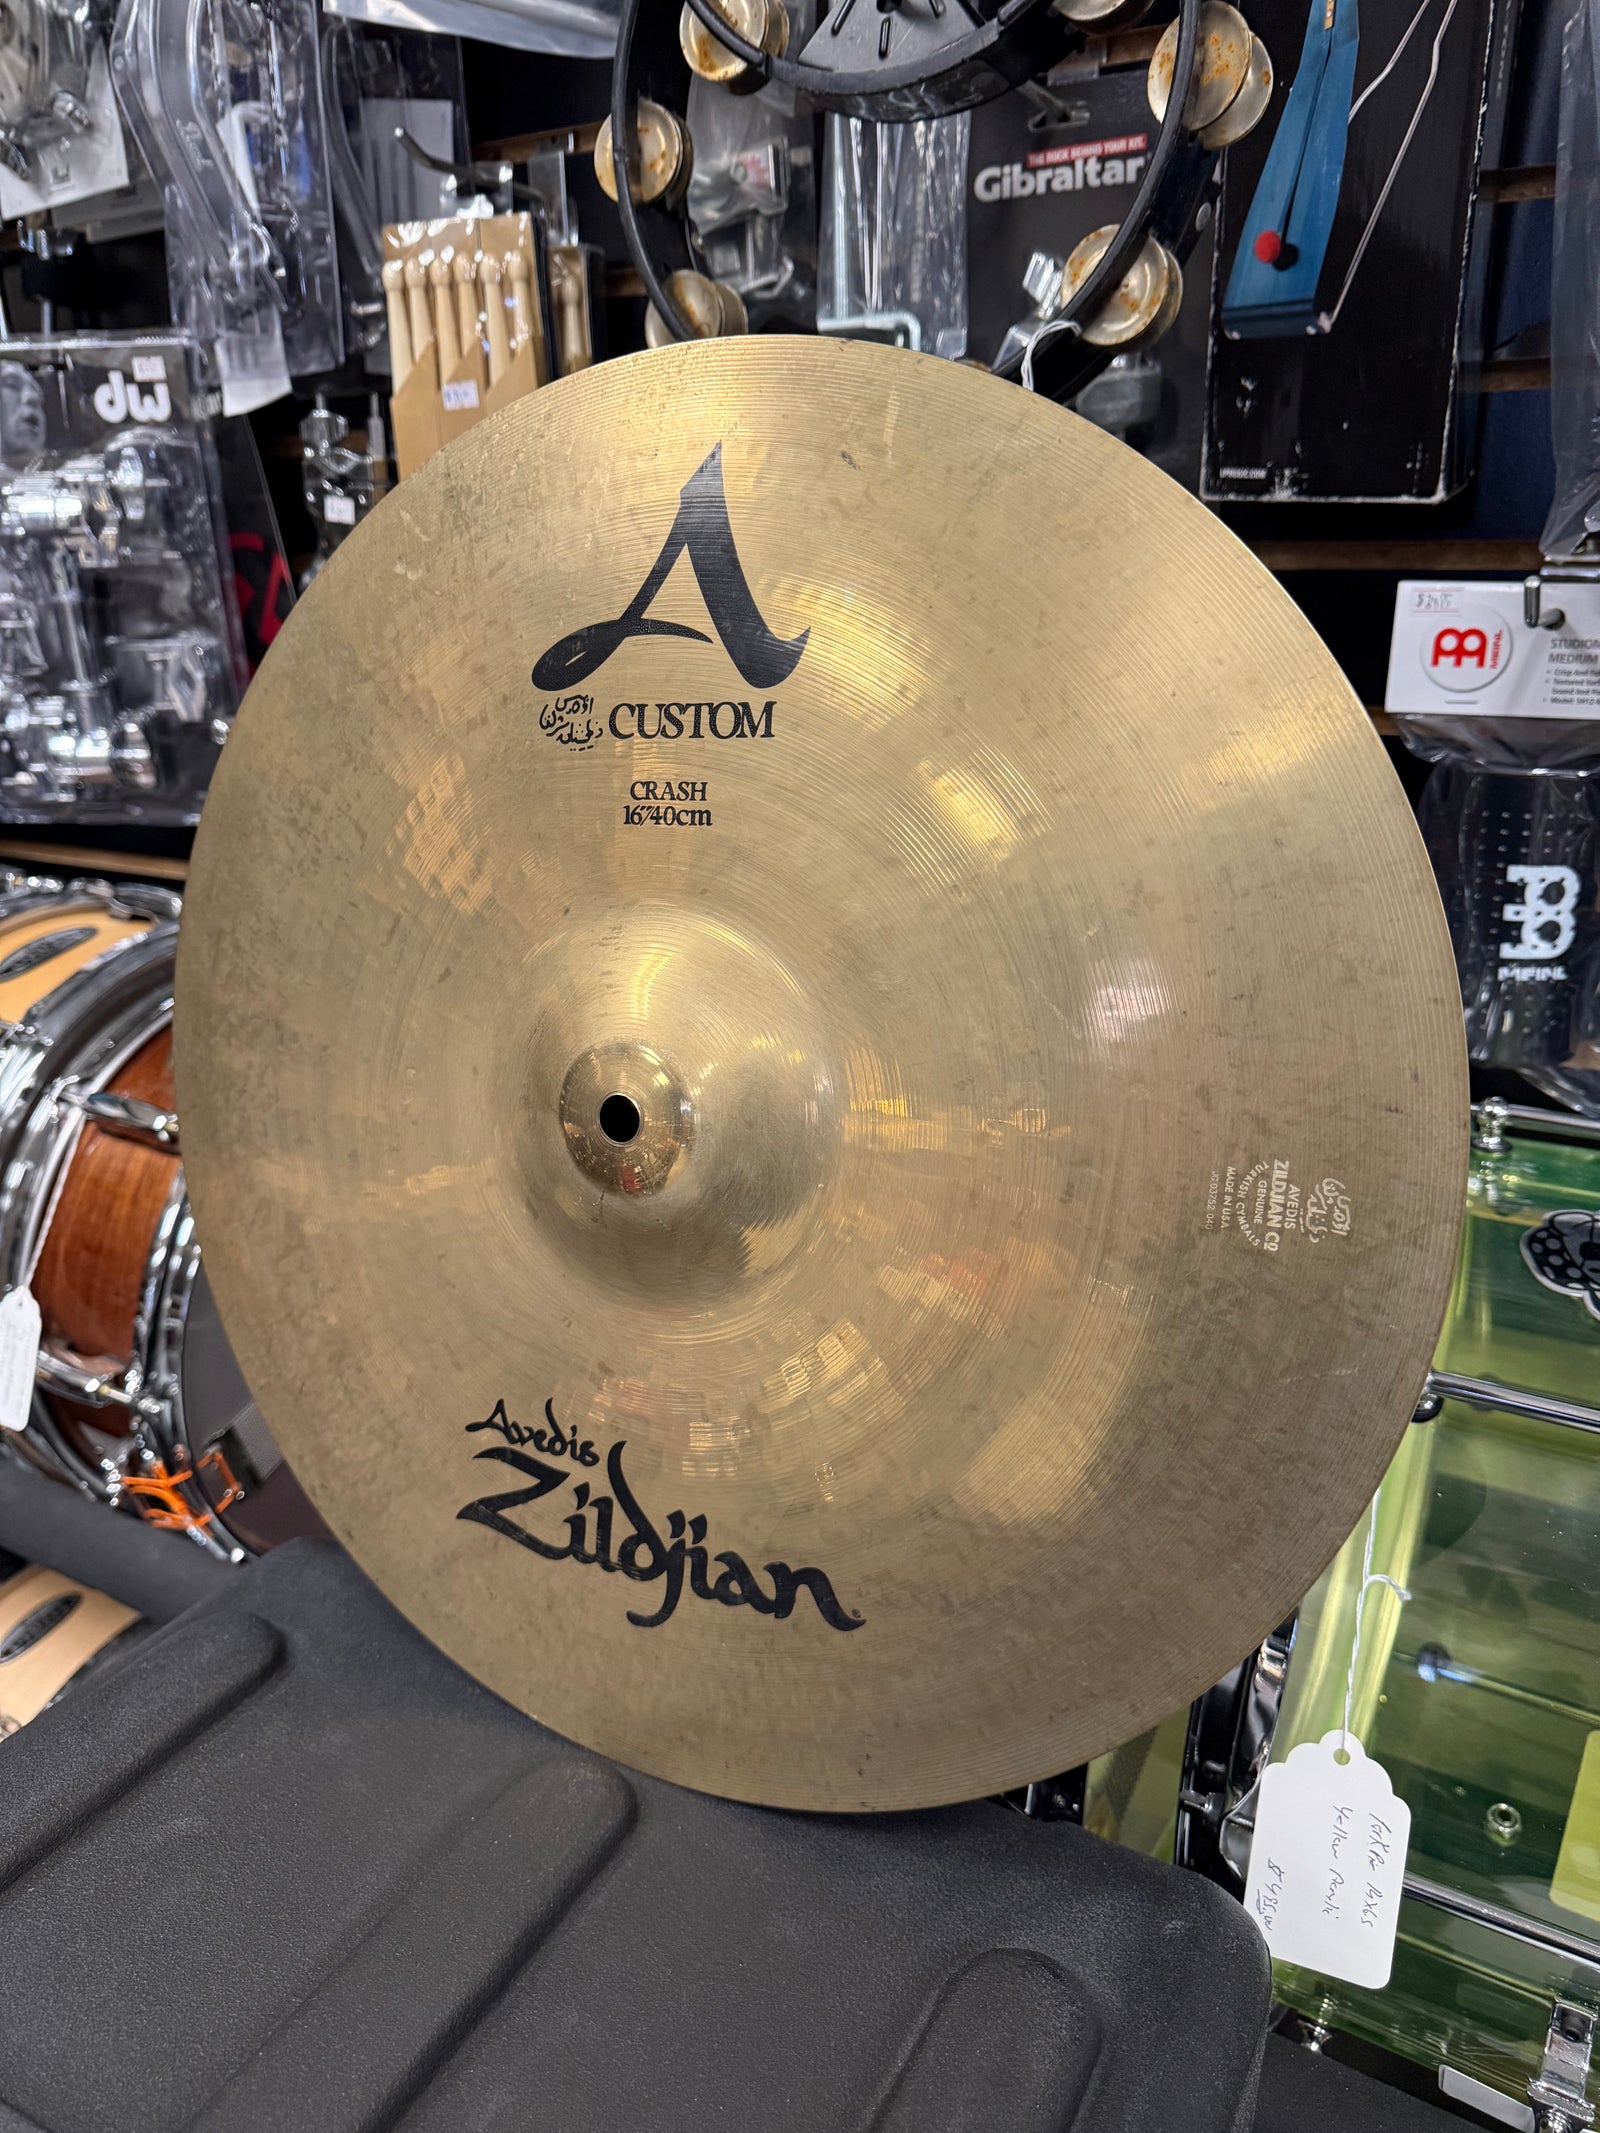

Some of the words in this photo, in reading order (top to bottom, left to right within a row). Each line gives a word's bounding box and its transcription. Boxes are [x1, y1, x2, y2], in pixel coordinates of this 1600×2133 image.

[974, 155, 1146, 202] Gibraltar
[94, 369, 171, 423] dw
[531, 439, 811, 691] A
[1488, 629, 1504, 670] MEINL
[1547, 652, 1598, 665] MEDIUM
[609, 701, 777, 739] CUSTOM
[630, 781, 708, 801] CRASH
[1223, 1195, 1233, 1206] IN
[1224, 1166, 1236, 1193] MADE
[1236, 1161, 1270, 1199] TURKISH
[1266, 1159, 1290, 1228] ZILDJIAN
[1220, 1207, 1231, 1229] USA
[1235, 1202, 1261, 1247] CYMBALS
[1254, 1180, 1267, 1225] GENUINE
[1284, 1184, 1300, 1229] AVEDIS
[465, 1397, 600, 1467] Avedis
[456, 1441, 866, 1631] Zildjian
